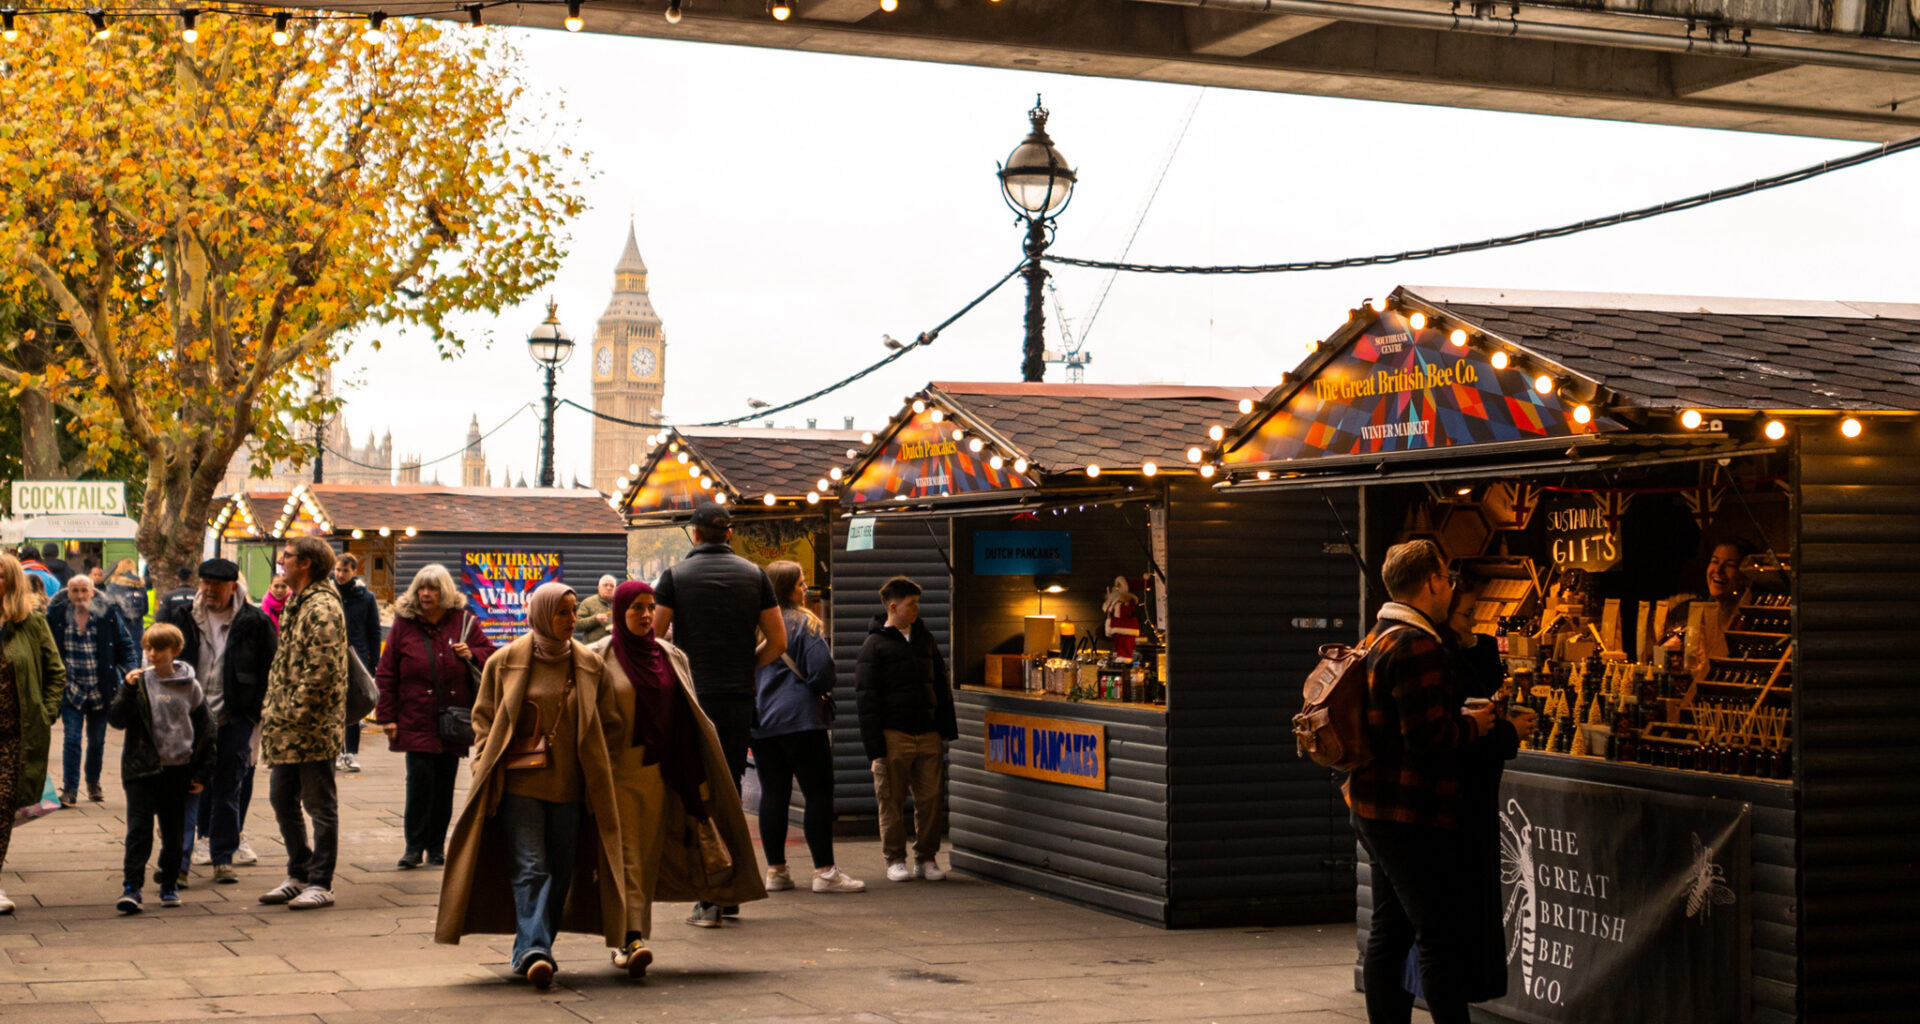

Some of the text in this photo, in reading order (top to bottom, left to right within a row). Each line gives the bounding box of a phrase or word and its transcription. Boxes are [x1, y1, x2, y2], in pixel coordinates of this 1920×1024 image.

[1375, 333, 1408, 345] SOUTHBANK
[1381, 343, 1402, 354] CENTRE
[1314, 357, 1479, 401] The Great British Bee Co.
[1361, 420, 1430, 441] WINTER MARKET
[902, 437, 957, 460] Dutch Pancakes
[18, 486, 117, 511] COCKTAILS
[1547, 508, 1606, 532] SUSTAINAB
[465, 552, 560, 567] SOUTHBANK
[985, 547, 1060, 560] DUTCH PANCAKES
[1552, 532, 1616, 564] GIFTS
[483, 567, 543, 580] CENTRE
[479, 588, 532, 605] Winte
[988, 723, 1098, 778] DUTCH PANCAKES
[1534, 826, 1579, 856] THE
[1538, 864, 1610, 899] GREAT
[1540, 901, 1626, 943] BRITISH
[1538, 938, 1574, 969] BEE
[1534, 976, 1564, 1006] CO.
